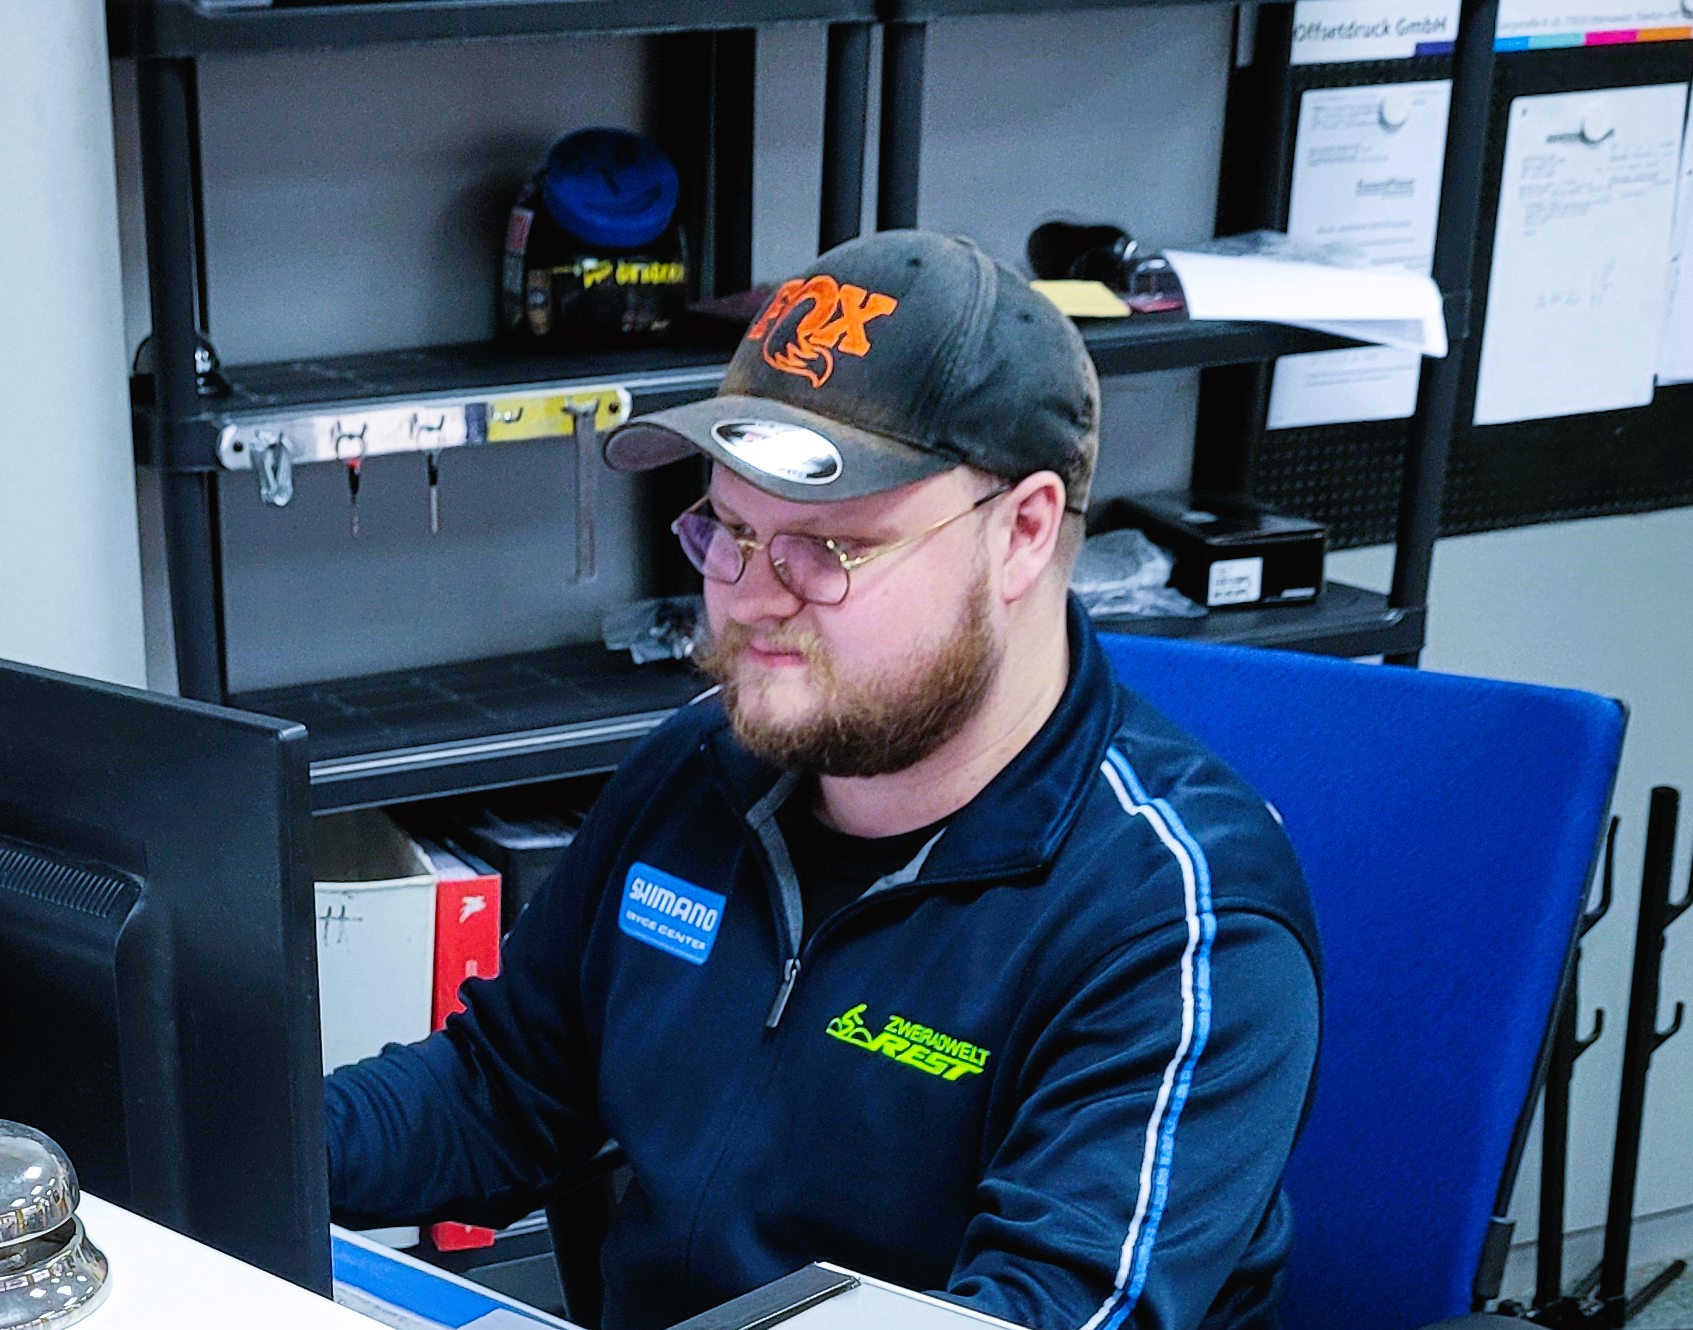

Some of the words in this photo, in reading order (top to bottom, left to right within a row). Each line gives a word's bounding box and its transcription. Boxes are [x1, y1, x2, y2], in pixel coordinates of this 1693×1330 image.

[1395, 15, 1448, 36] GmbH
[629, 877, 718, 933] SHIMANO
[869, 1031, 985, 1081] REST
